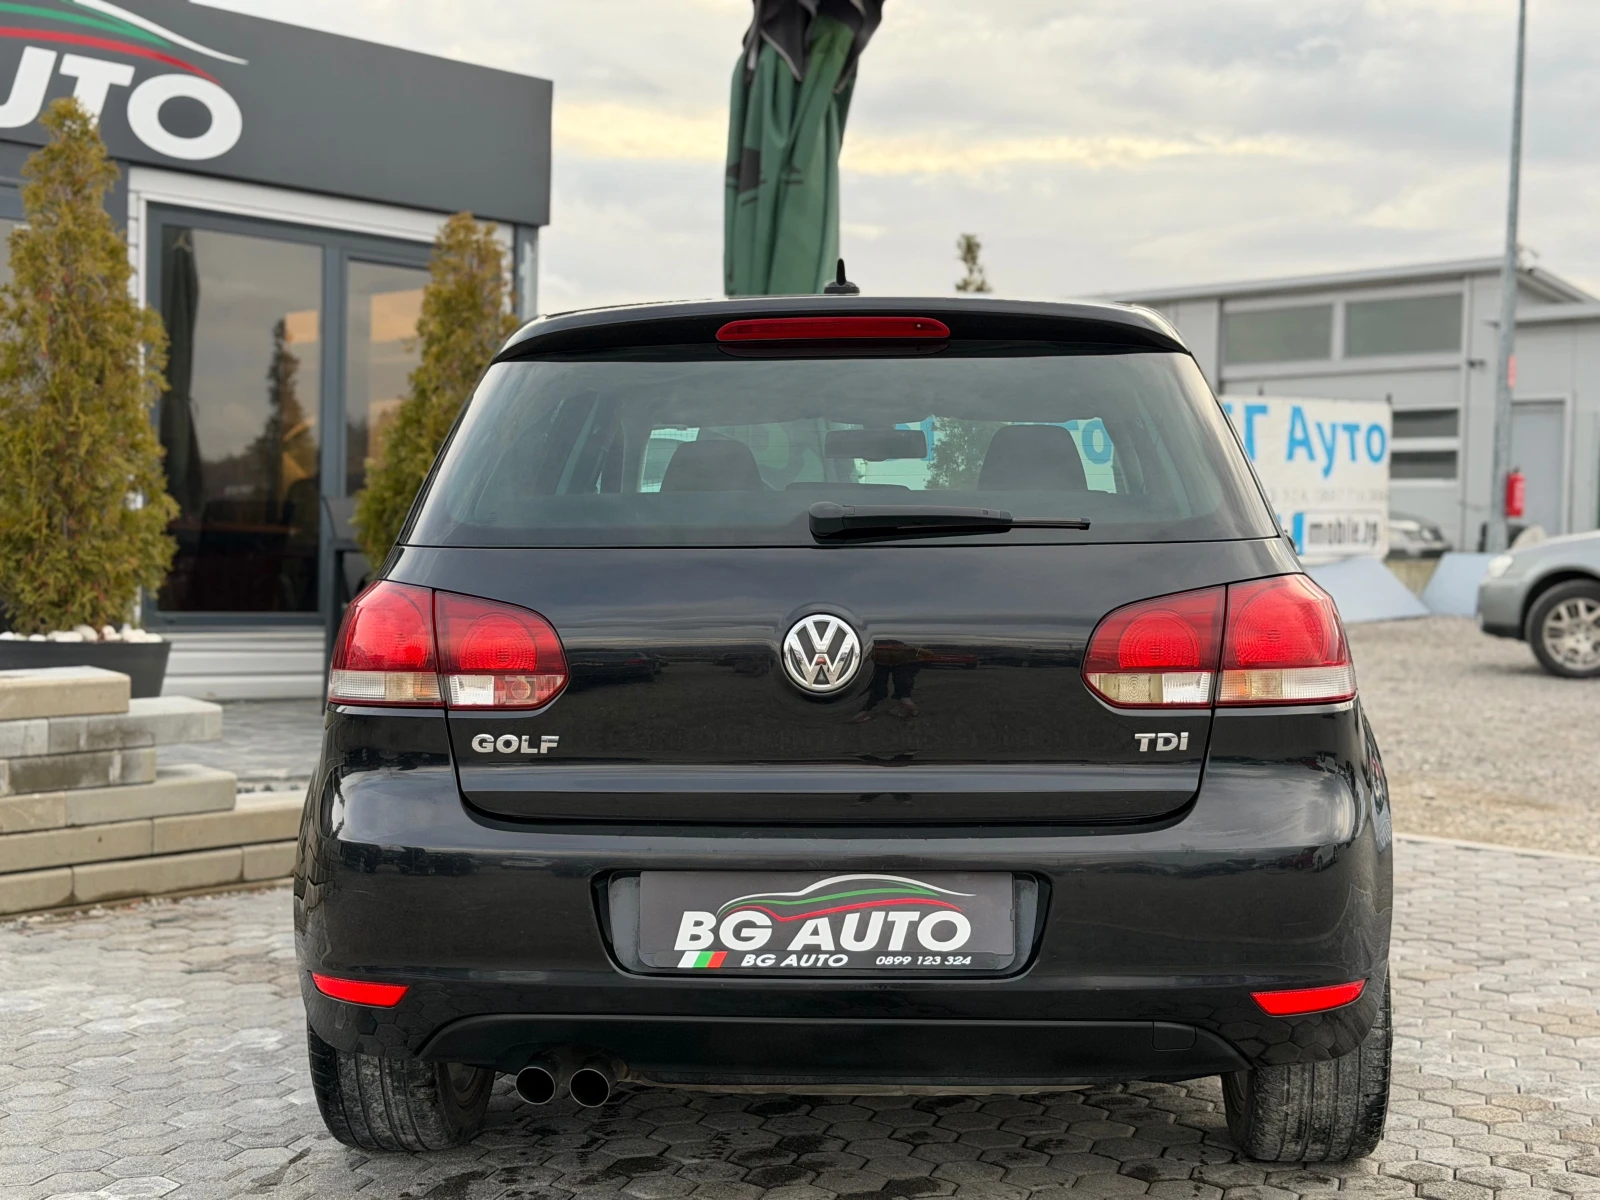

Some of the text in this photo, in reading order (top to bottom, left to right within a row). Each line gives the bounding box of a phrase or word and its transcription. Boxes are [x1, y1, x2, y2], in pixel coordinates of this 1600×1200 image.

[1286, 405, 1387, 479] Ауто
[471, 733, 560, 754] GOLF
[674, 910, 972, 952] BG AUTO
[740, 953, 972, 968] BG AUTO 0899 123 324
